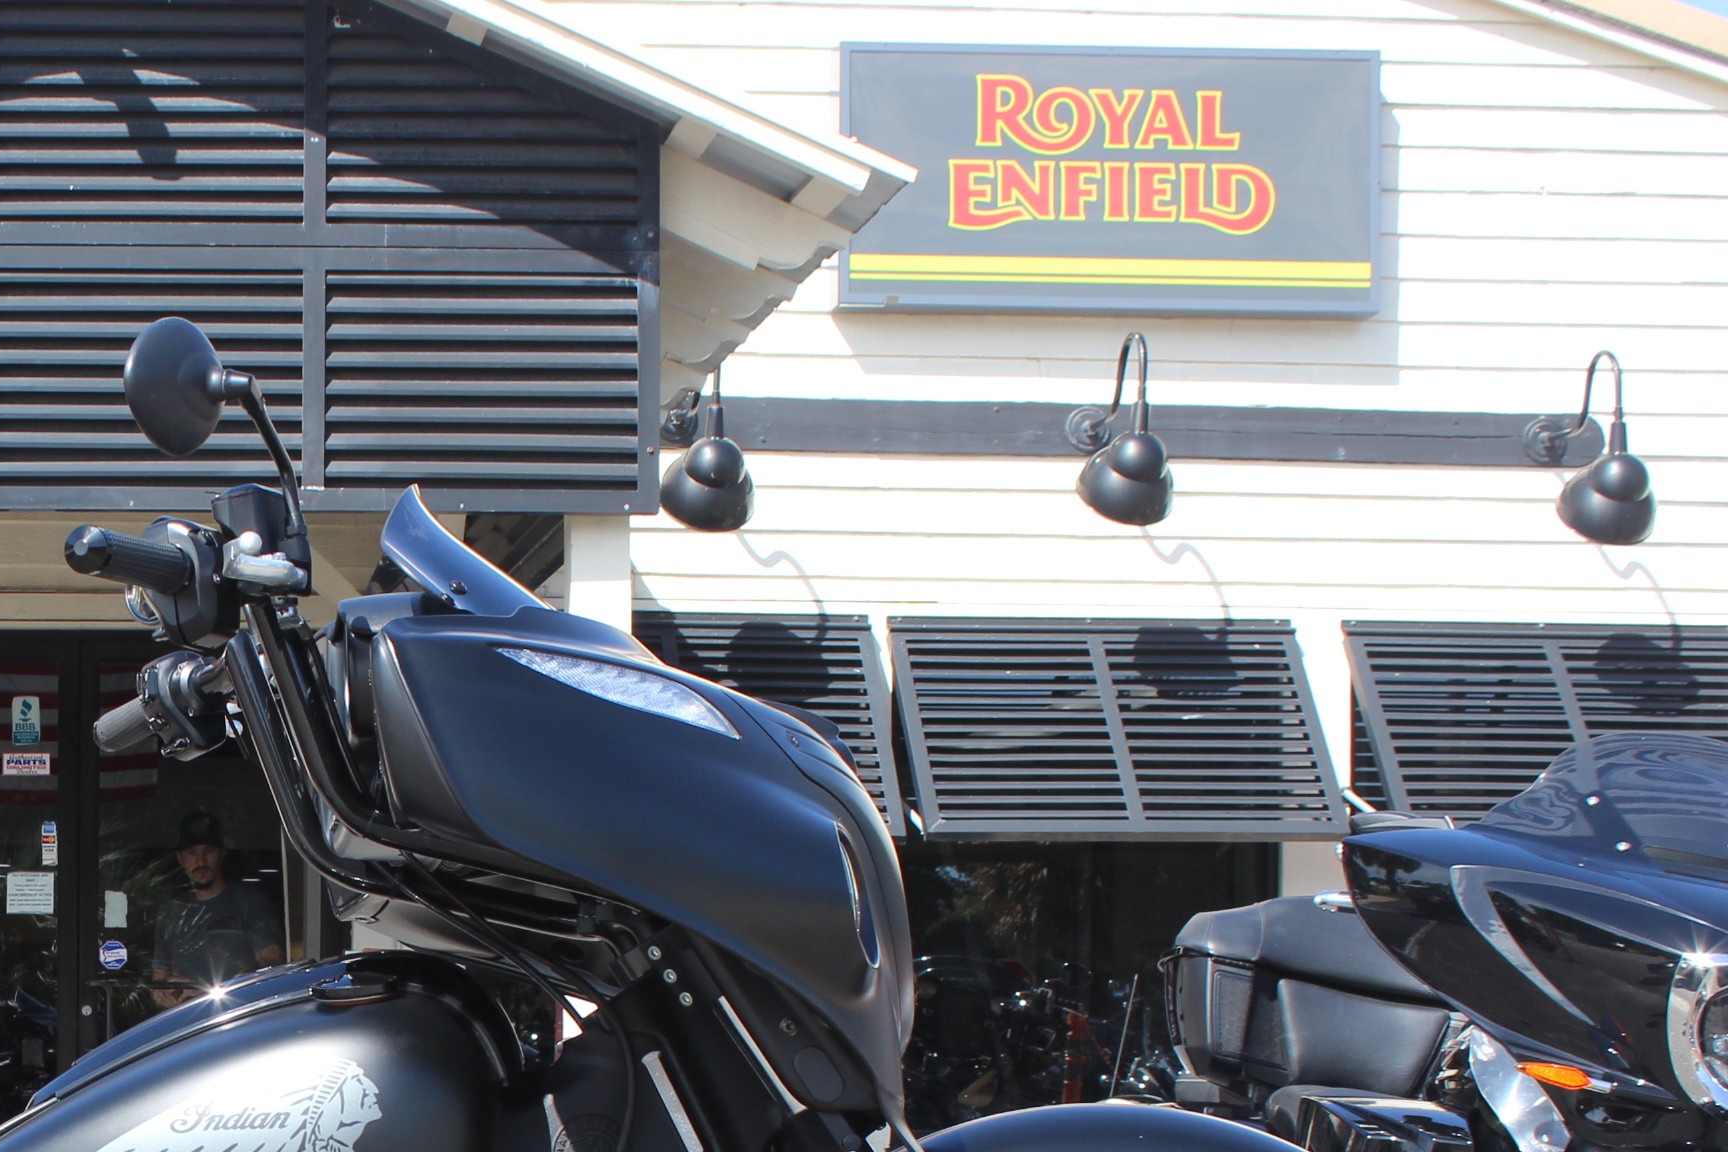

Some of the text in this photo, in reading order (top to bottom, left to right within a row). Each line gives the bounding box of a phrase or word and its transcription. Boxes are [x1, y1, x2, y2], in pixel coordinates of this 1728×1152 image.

[975, 73, 1241, 155] ROYAL
[948, 159, 1276, 236] ENFIELD
[15, 723, 36, 731] BBB
[170, 1101, 291, 1133] Indian
